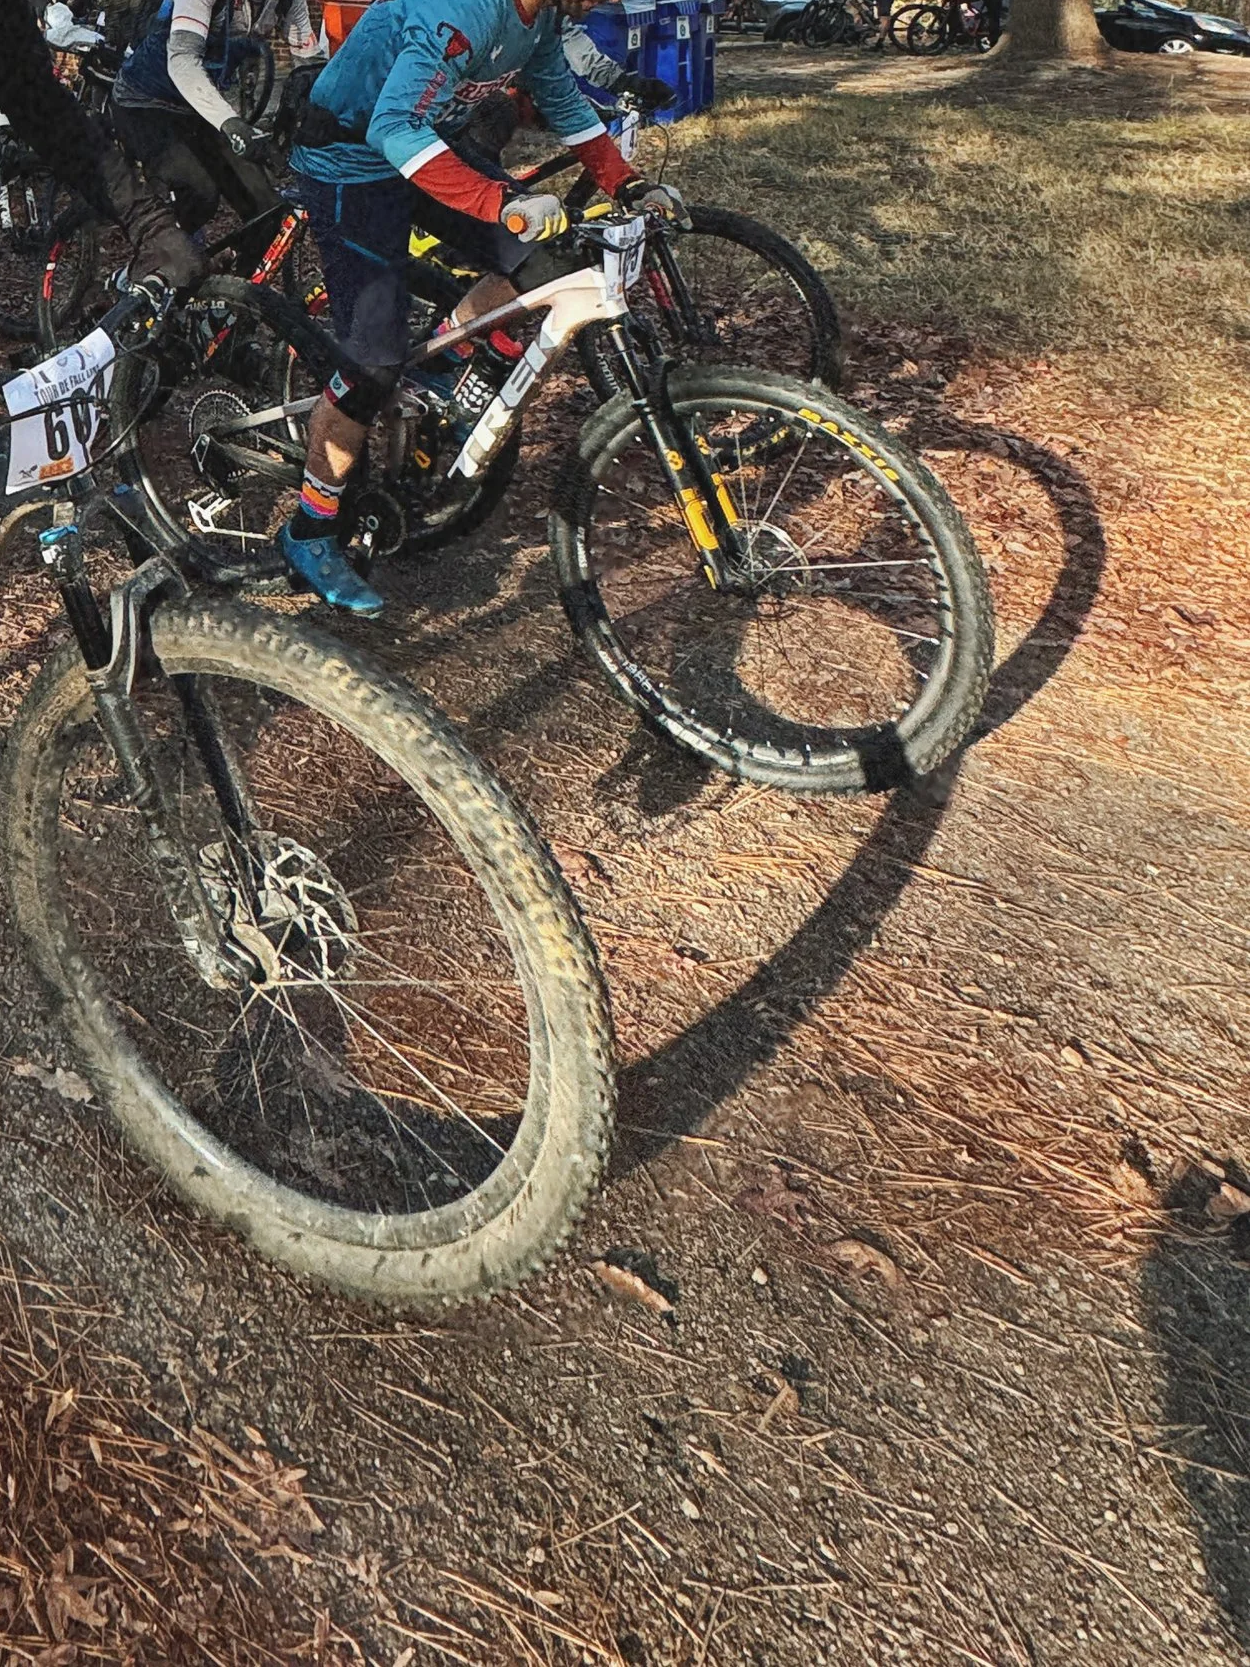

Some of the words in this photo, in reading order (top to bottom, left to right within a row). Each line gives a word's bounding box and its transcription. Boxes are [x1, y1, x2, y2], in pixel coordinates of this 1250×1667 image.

[34, 383, 60, 406] TOUR
[59, 381, 70, 395] DE
[447, 309, 563, 478] TREK
